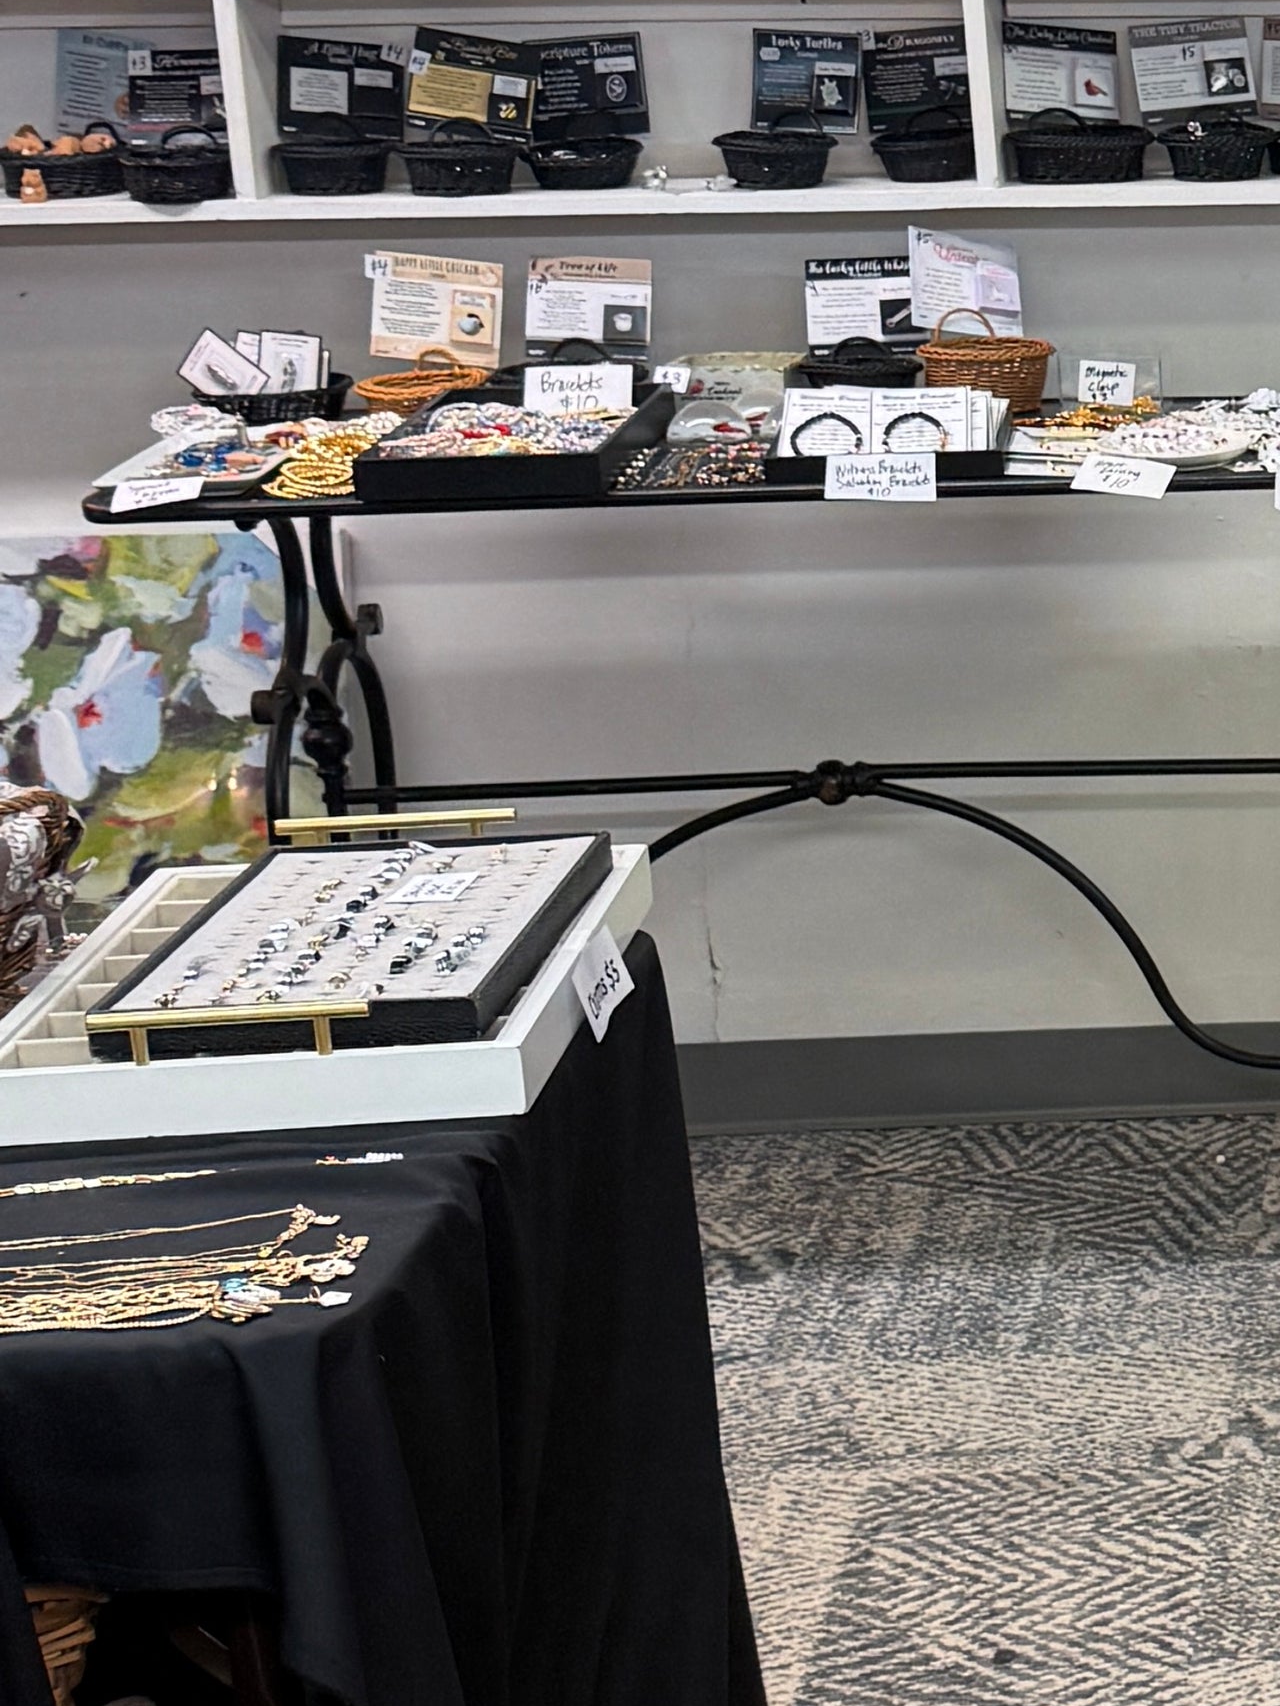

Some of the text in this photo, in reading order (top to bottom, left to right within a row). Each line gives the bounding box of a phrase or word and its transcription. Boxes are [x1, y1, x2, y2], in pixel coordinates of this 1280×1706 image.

[1132, 20, 1242, 39] THE TINY TRACTOR
[589, 40, 634, 55] Tokens
[771, 34, 843, 51] Lucky Turtles
